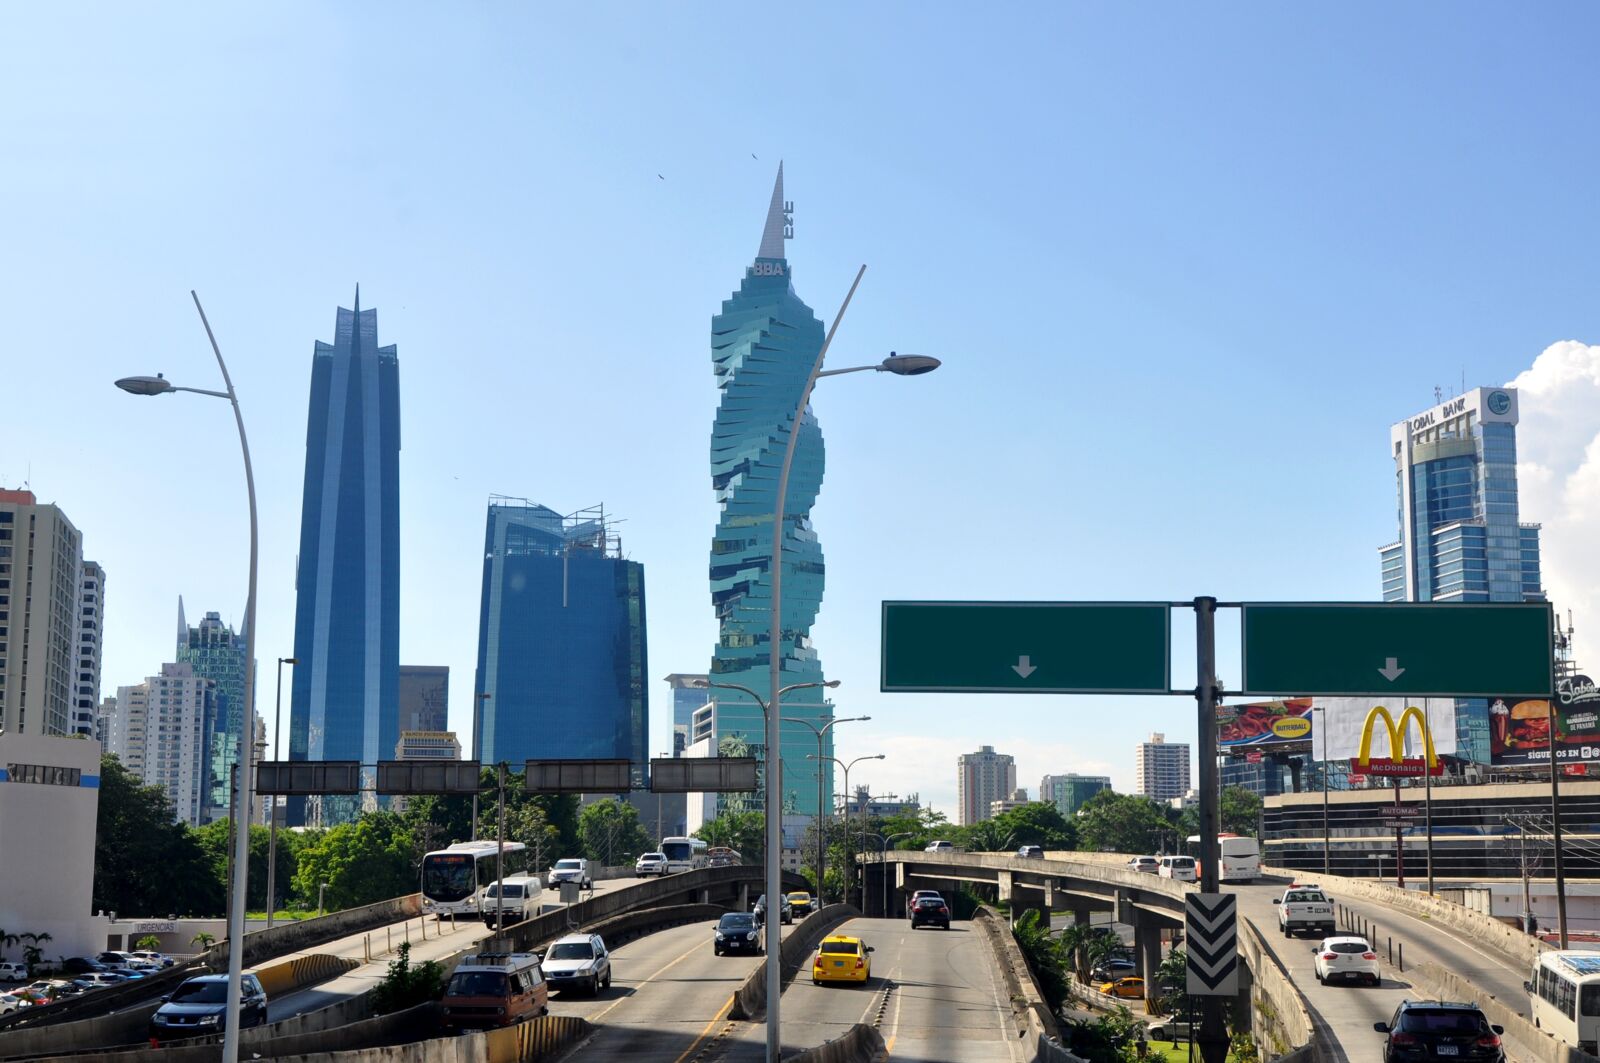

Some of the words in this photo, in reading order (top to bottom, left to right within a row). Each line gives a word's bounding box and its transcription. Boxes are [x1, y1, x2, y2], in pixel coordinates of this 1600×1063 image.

[1409, 412, 1435, 432] LOBAL
[1443, 398, 1465, 418] BANK
[1276, 723, 1306, 732] BUTTERBALL
[1528, 750, 1566, 759] SÍGUEOS
[1568, 749, 1579, 757] EN
[1371, 764, 1424, 773] McDonald's
[137, 922, 174, 932] URGENCIAS
